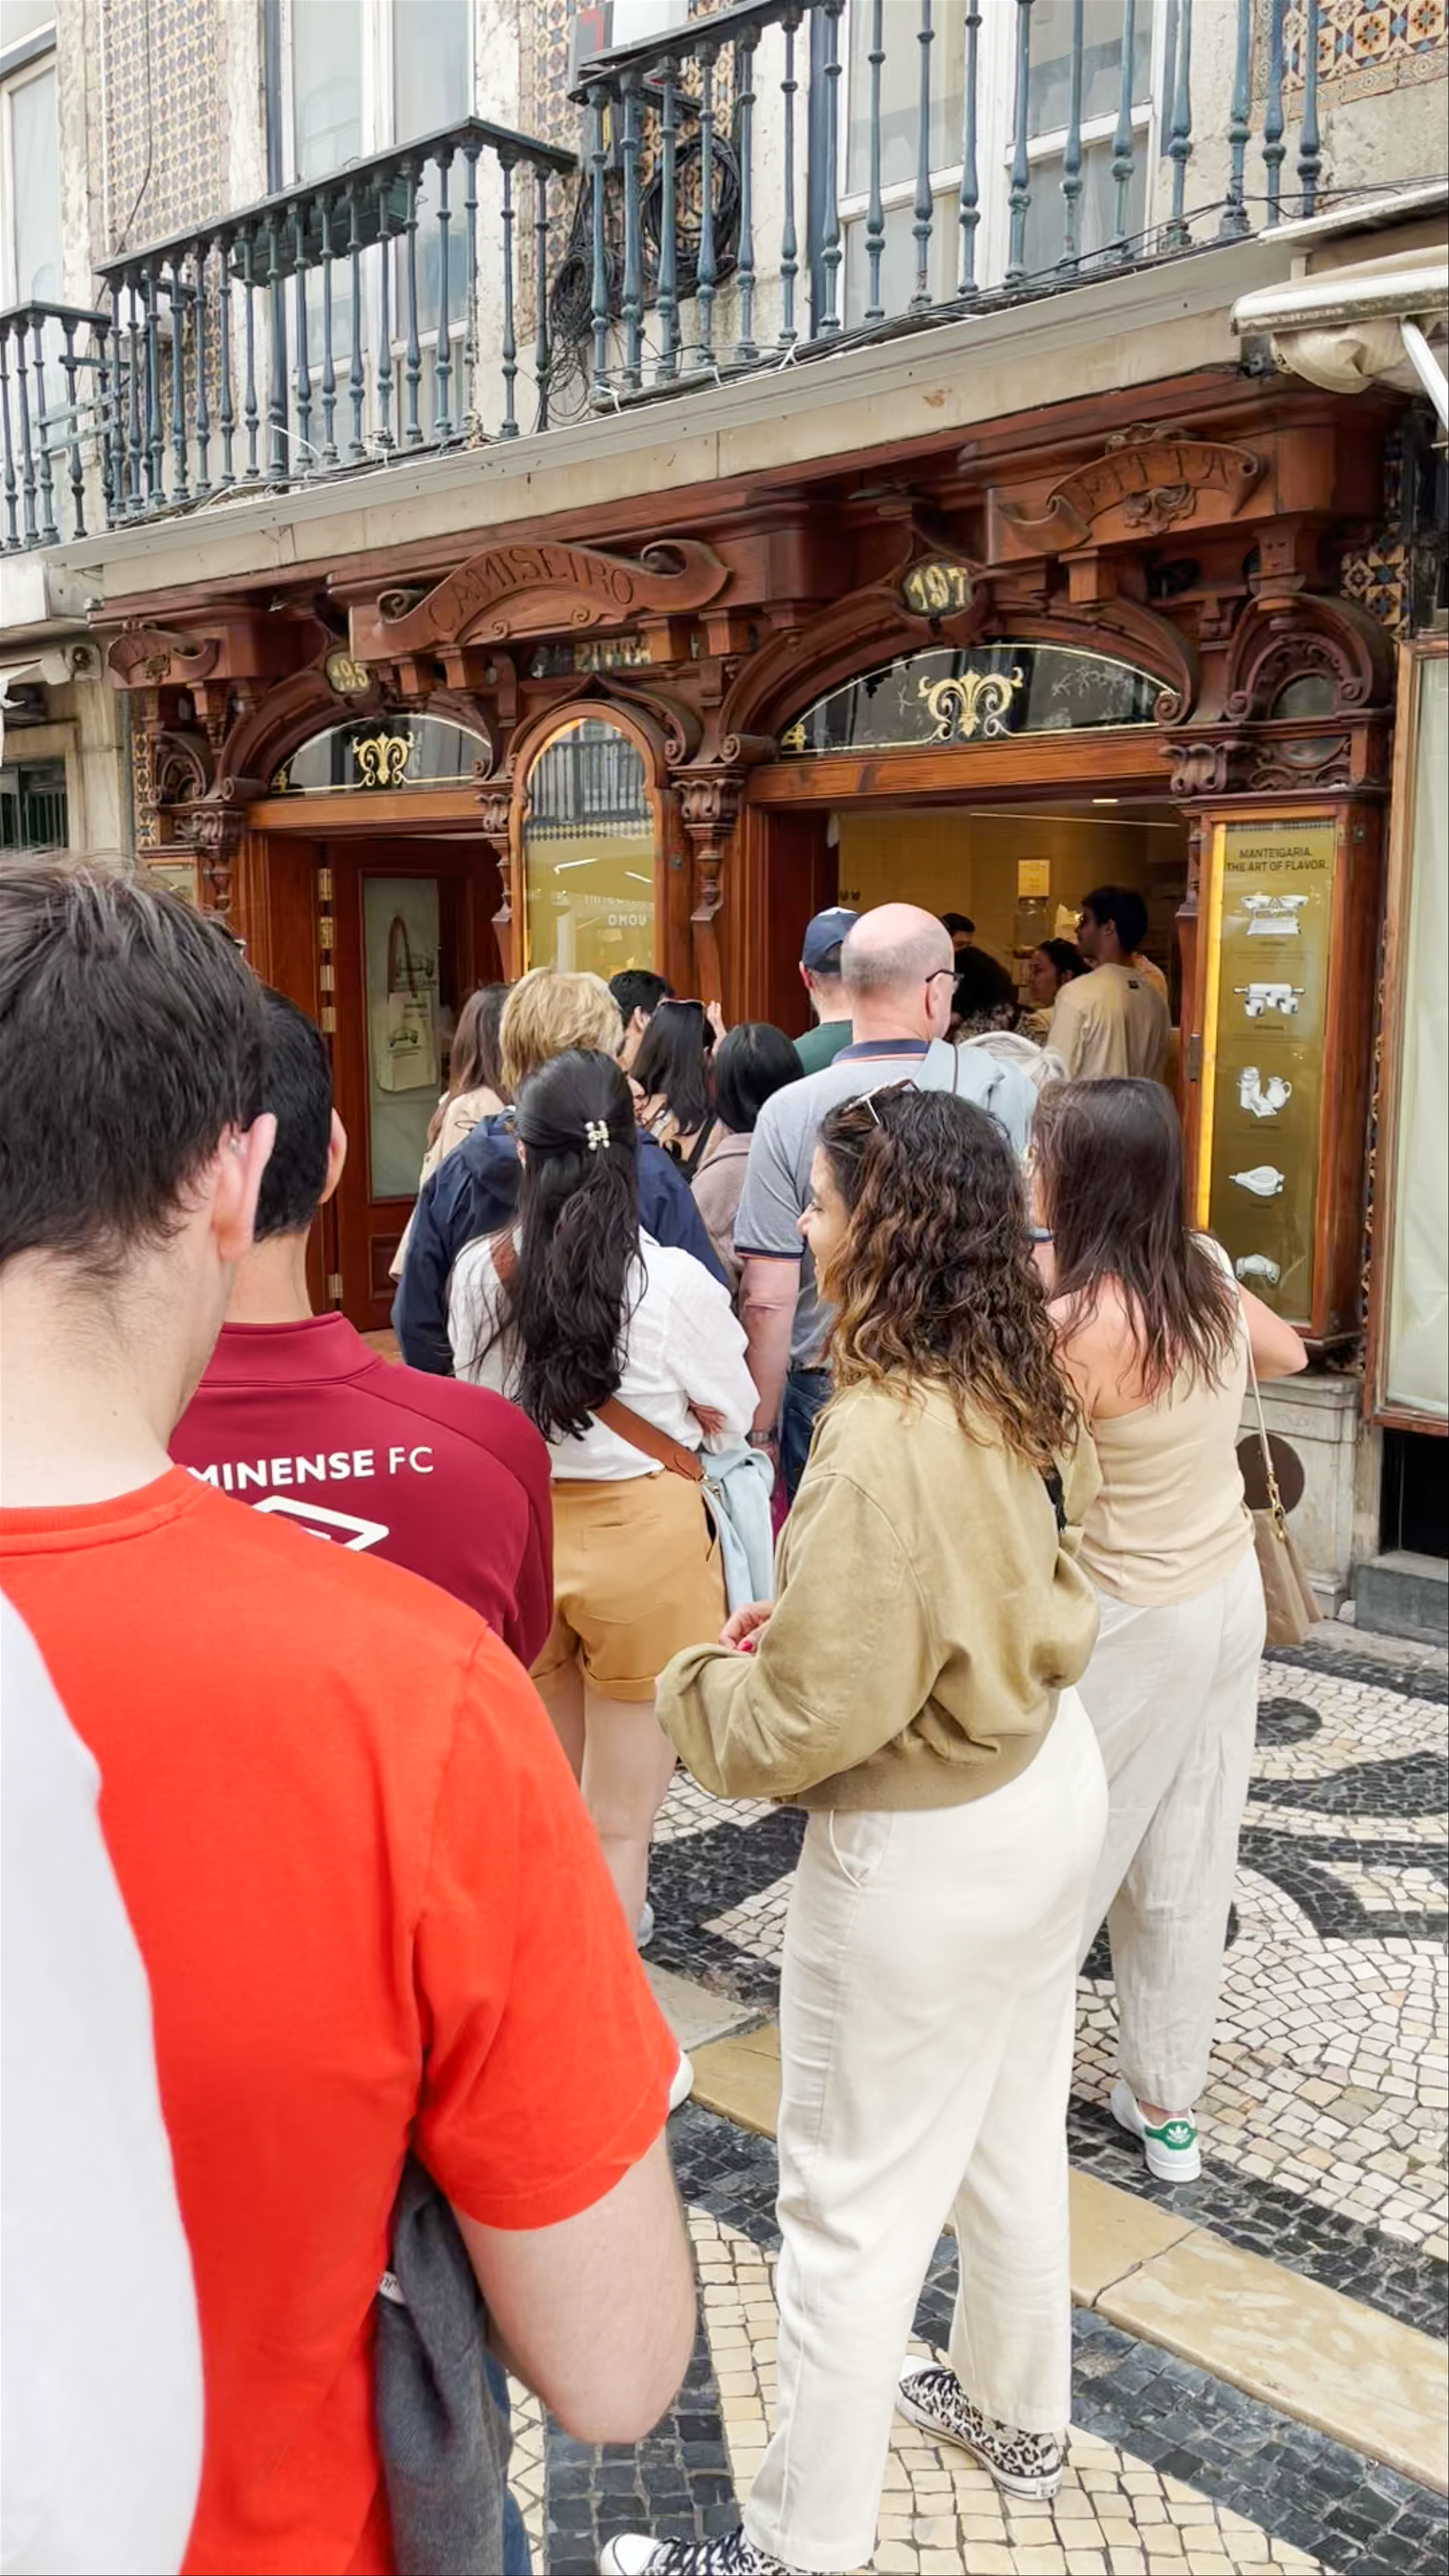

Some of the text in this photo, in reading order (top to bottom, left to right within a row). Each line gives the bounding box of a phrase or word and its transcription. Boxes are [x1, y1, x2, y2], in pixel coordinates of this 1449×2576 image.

[427, 548, 634, 632] CAMISEIRO
[909, 566, 966, 609] 197
[332, 660, 368, 692] 195
[1226, 862, 1245, 872] THE
[1248, 861, 1267, 871] ART
[1269, 861, 1282, 871] OF
[388, 1447, 434, 1474] FC
